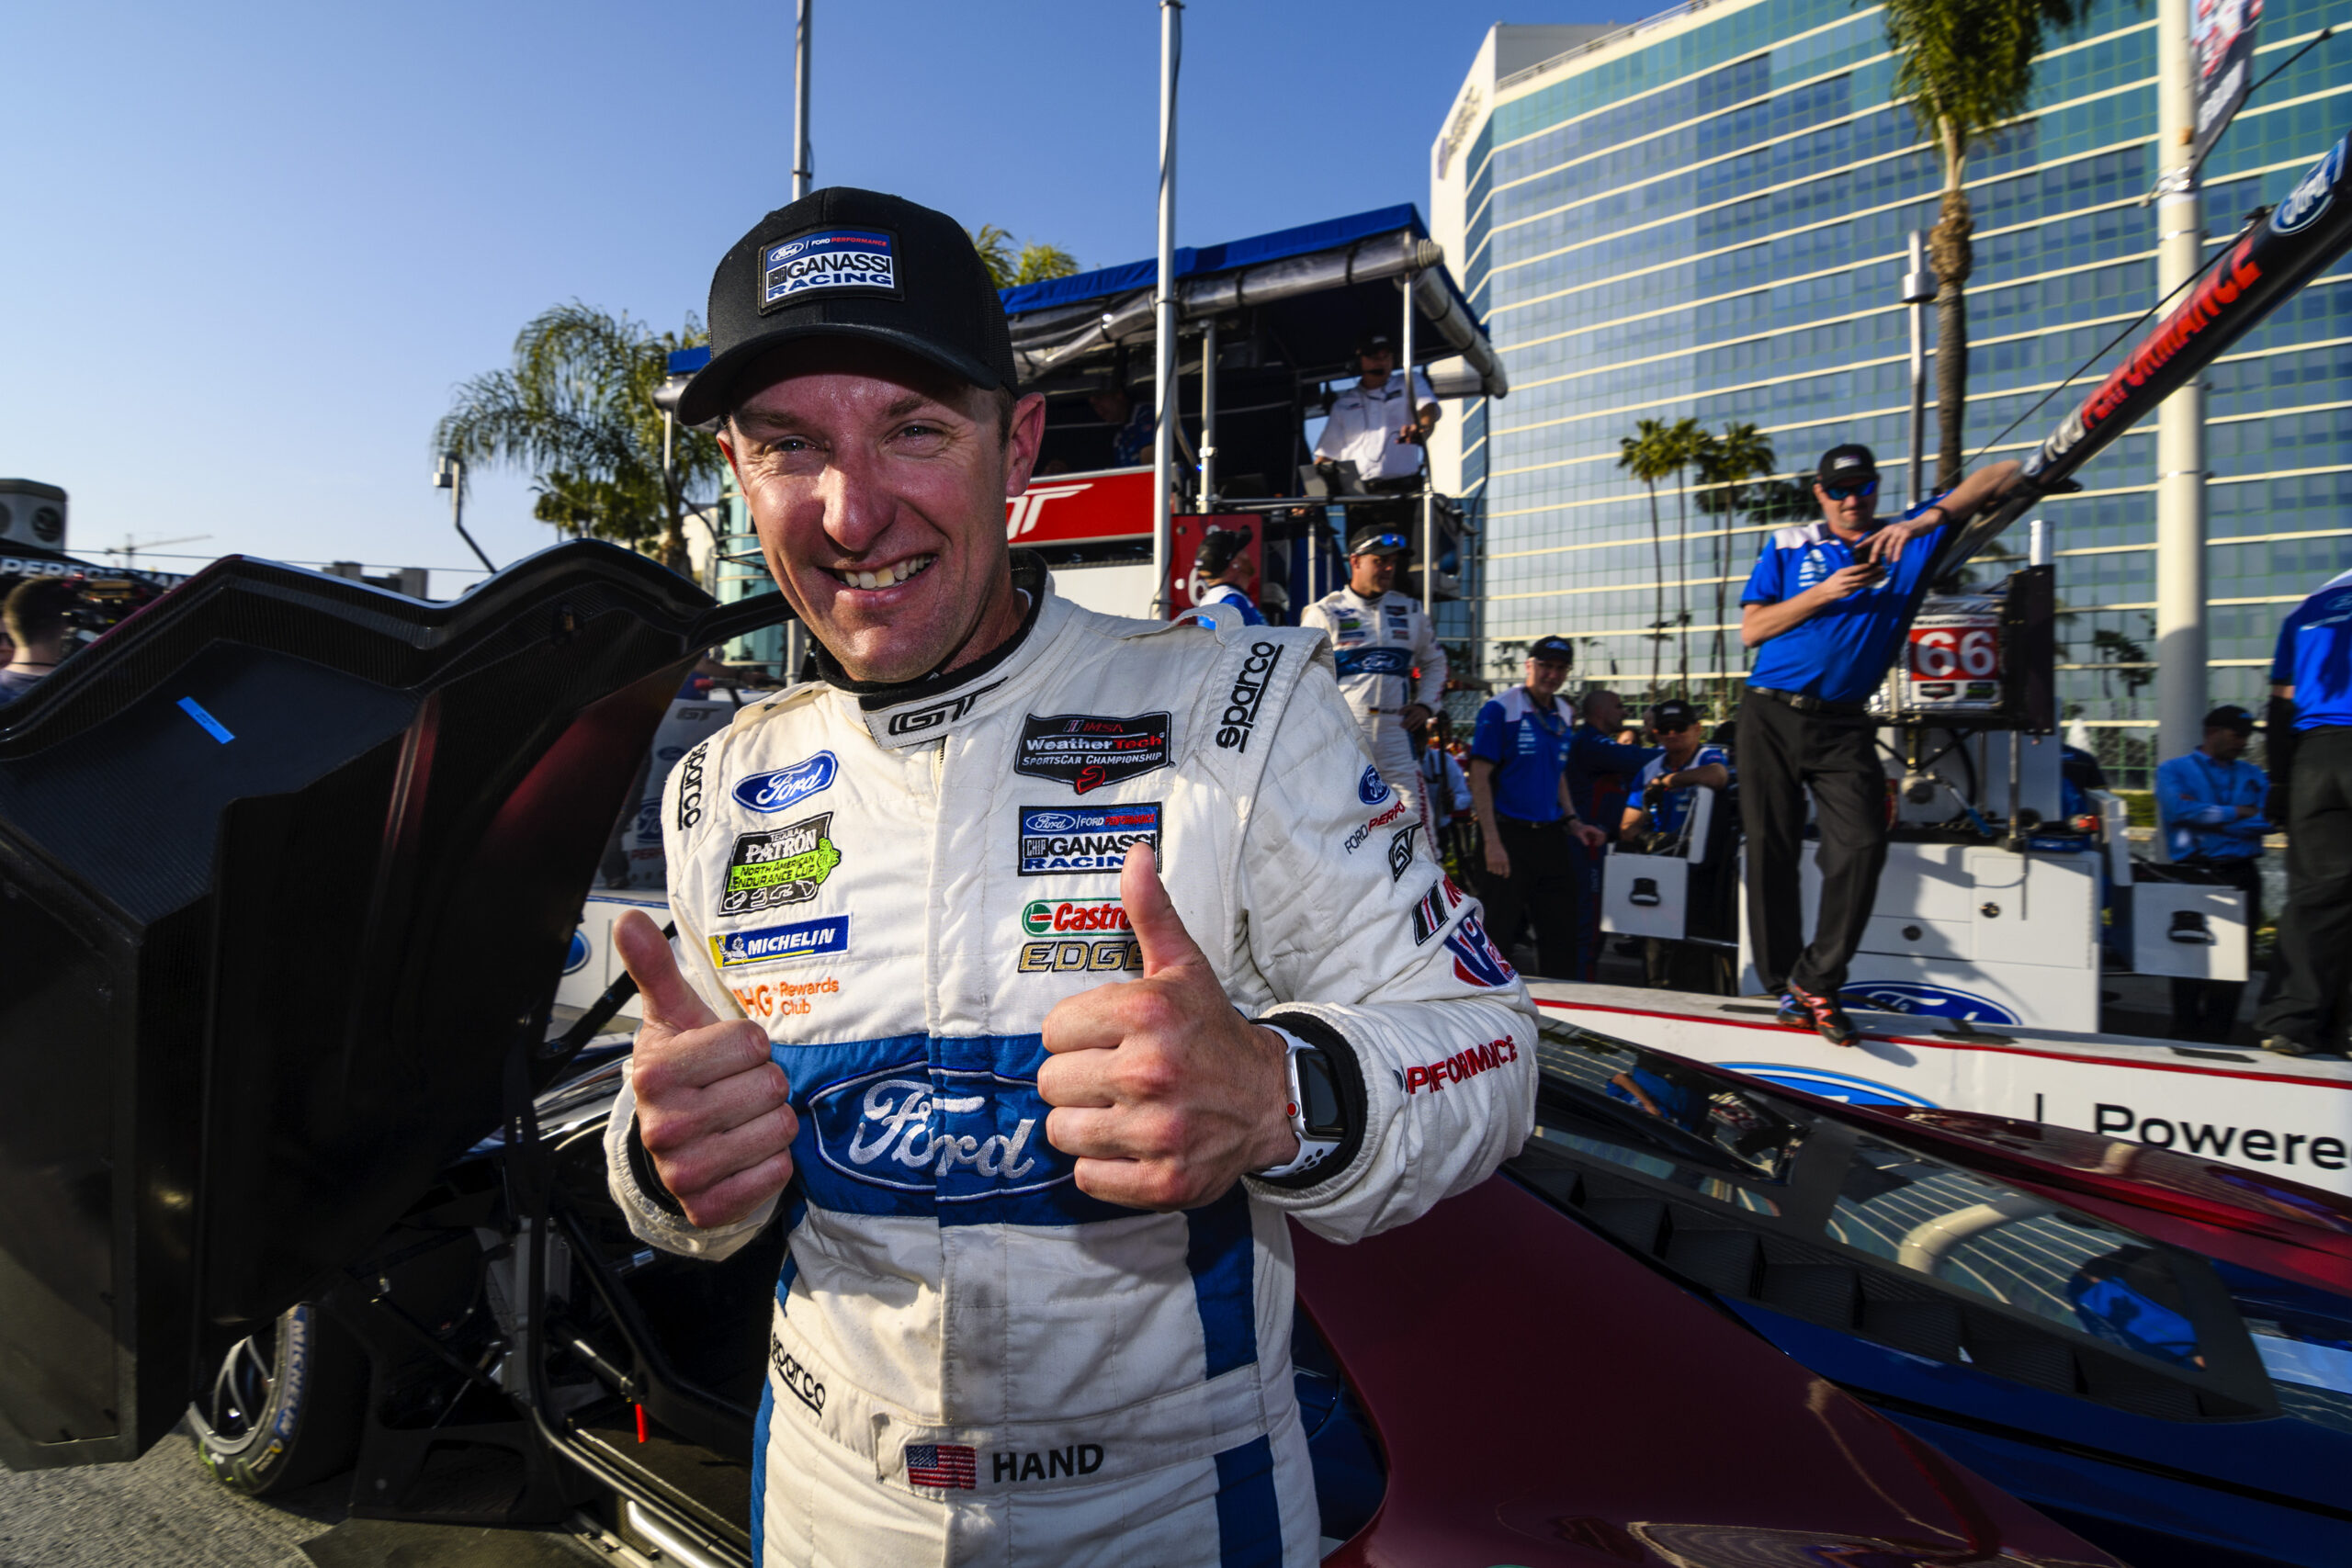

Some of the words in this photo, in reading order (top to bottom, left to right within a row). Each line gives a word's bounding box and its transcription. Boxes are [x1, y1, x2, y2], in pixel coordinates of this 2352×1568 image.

[775, 244, 797, 259] Ford
[811, 238, 831, 246] FORD
[831, 237, 888, 247] PERFORMANCE
[787, 254, 891, 279] GANASSI
[768, 273, 892, 299] RACING
[1917, 630, 1996, 677] 66
[888, 676, 1009, 736] GT
[1216, 641, 1276, 749] sparco
[1026, 736, 1163, 752] WeatherTech
[1085, 752, 1162, 765] CHAMPIONSHIP
[756, 763, 824, 805] Ford
[1035, 815, 1067, 829] Ford
[1080, 817, 1104, 827] FORD
[1344, 824, 1369, 855] FORD
[1368, 800, 1406, 832] PERFO
[745, 829, 817, 863] PATRÓN
[1026, 840, 1046, 857] CHIP
[1049, 833, 1156, 856] GANASSI
[741, 866, 772, 876] NORTH
[773, 855, 815, 872] AMERICAN
[1023, 856, 1125, 869] RACIN
[732, 869, 792, 888] ENDURANCE
[794, 864, 815, 878] CUP
[1054, 902, 1133, 931] Castro
[748, 928, 836, 957] MICHELIN
[780, 976, 840, 997] Rewards
[780, 998, 811, 1016] Club
[849, 1079, 1036, 1179] Ford
[992, 1443, 1104, 1483] HAND
